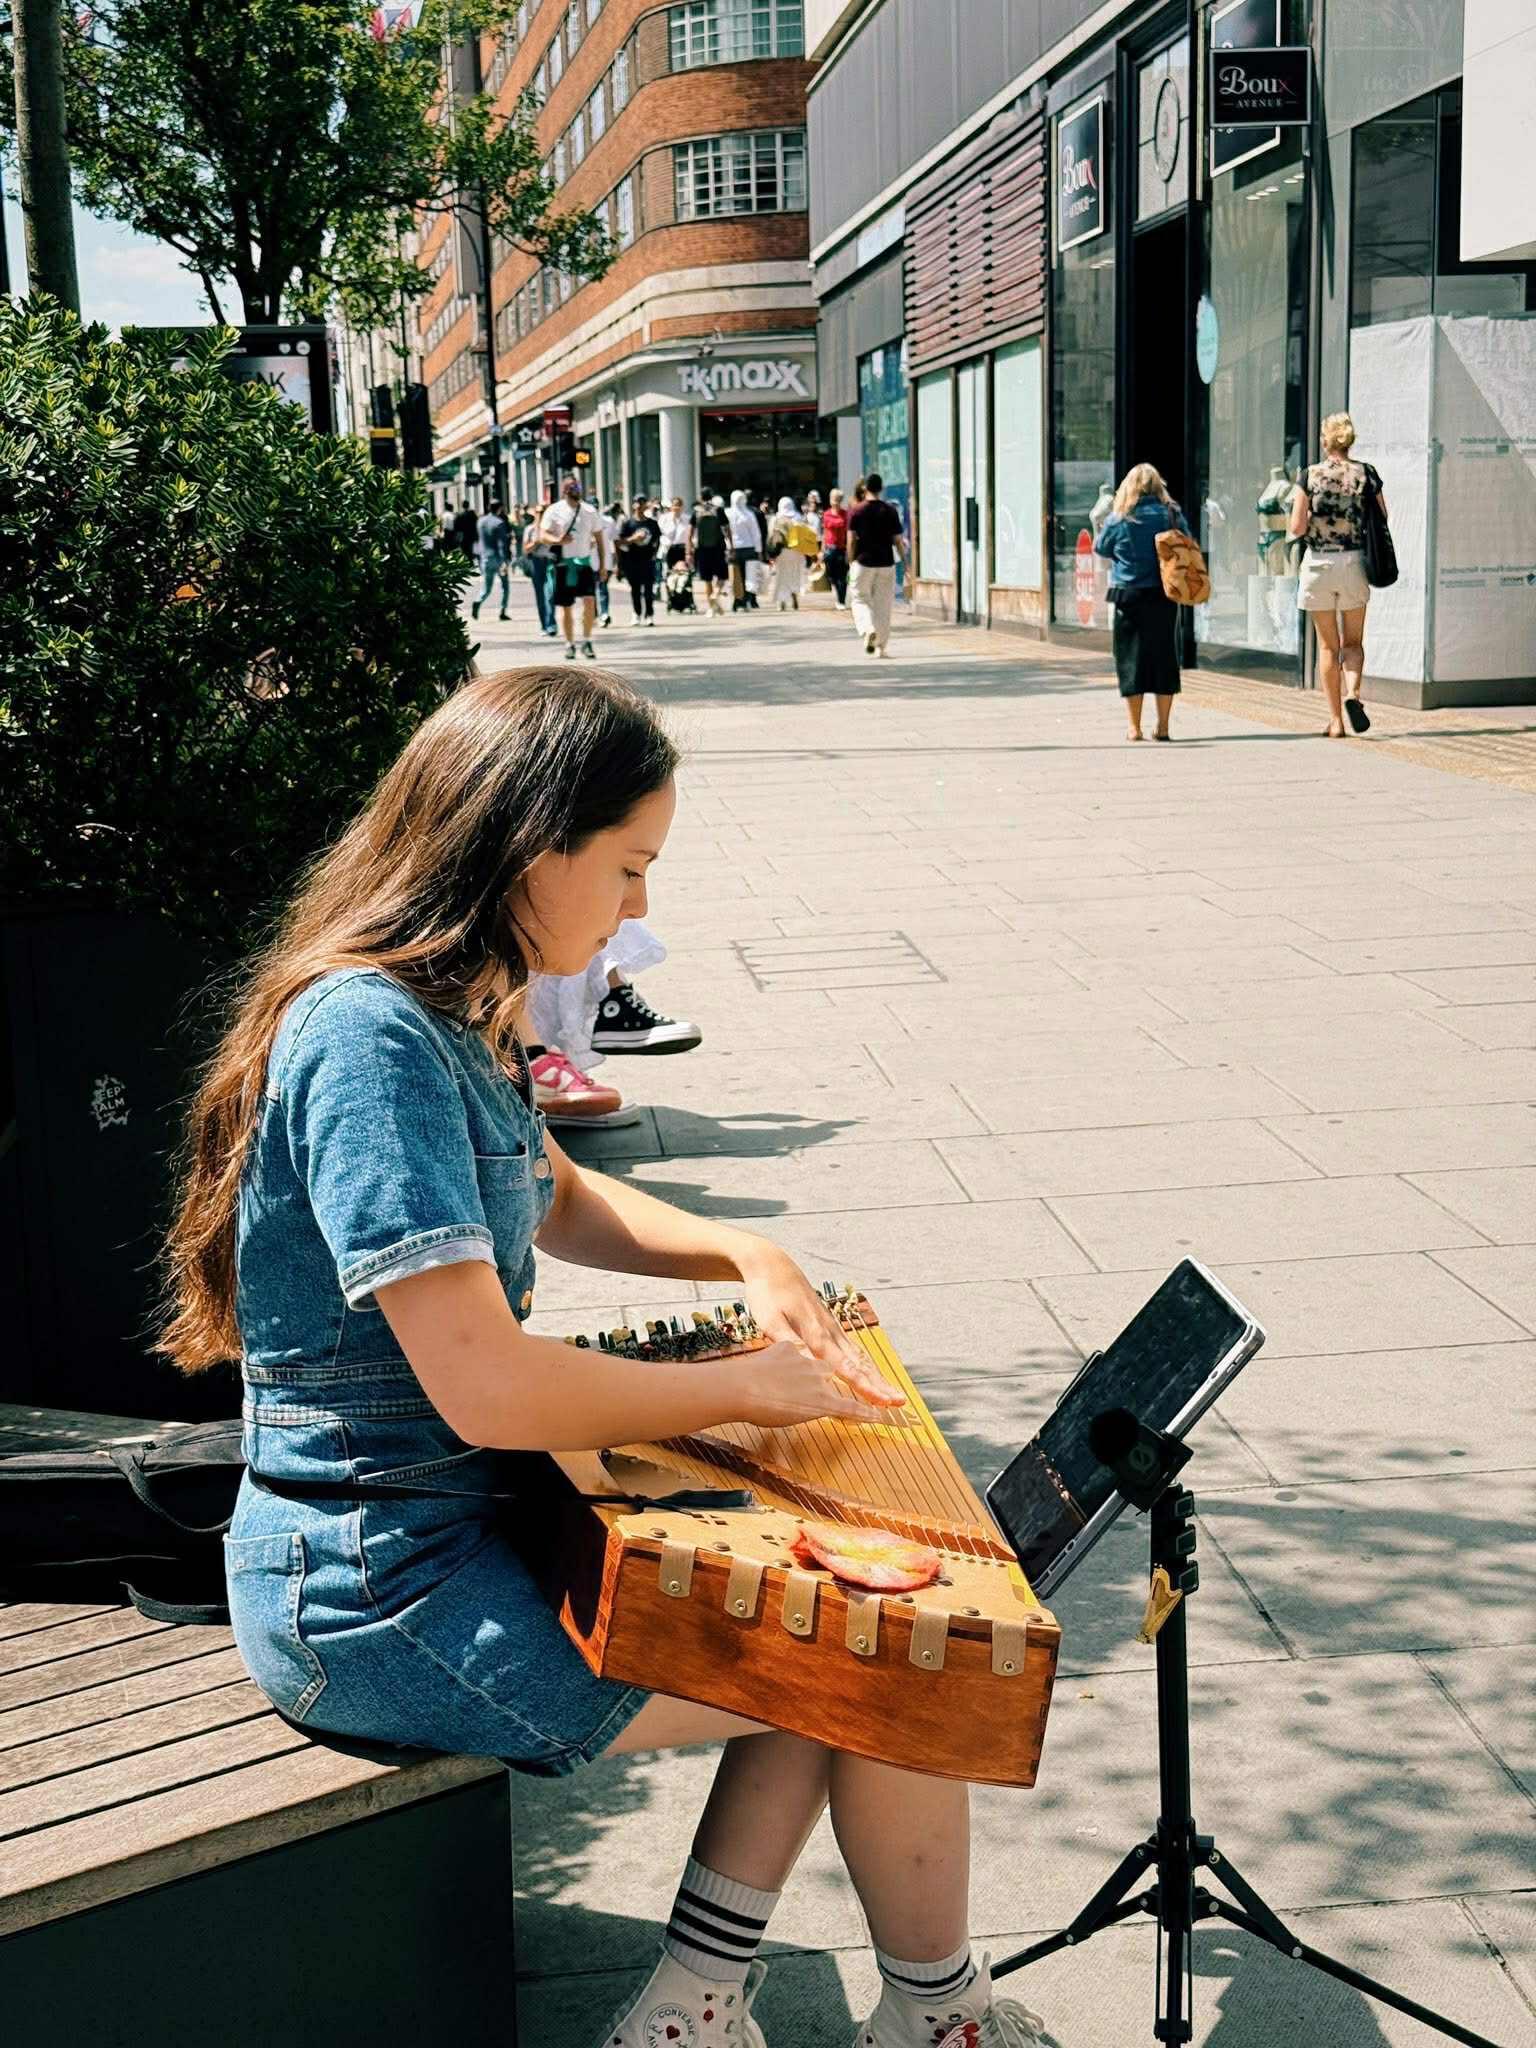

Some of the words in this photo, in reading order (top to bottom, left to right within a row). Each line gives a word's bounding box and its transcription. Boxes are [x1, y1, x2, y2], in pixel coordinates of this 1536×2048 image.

[1219, 66, 1297, 97] Boux
[1236, 99, 1284, 109] AVENUE
[658, 2007, 696, 2036] CONVERSE
